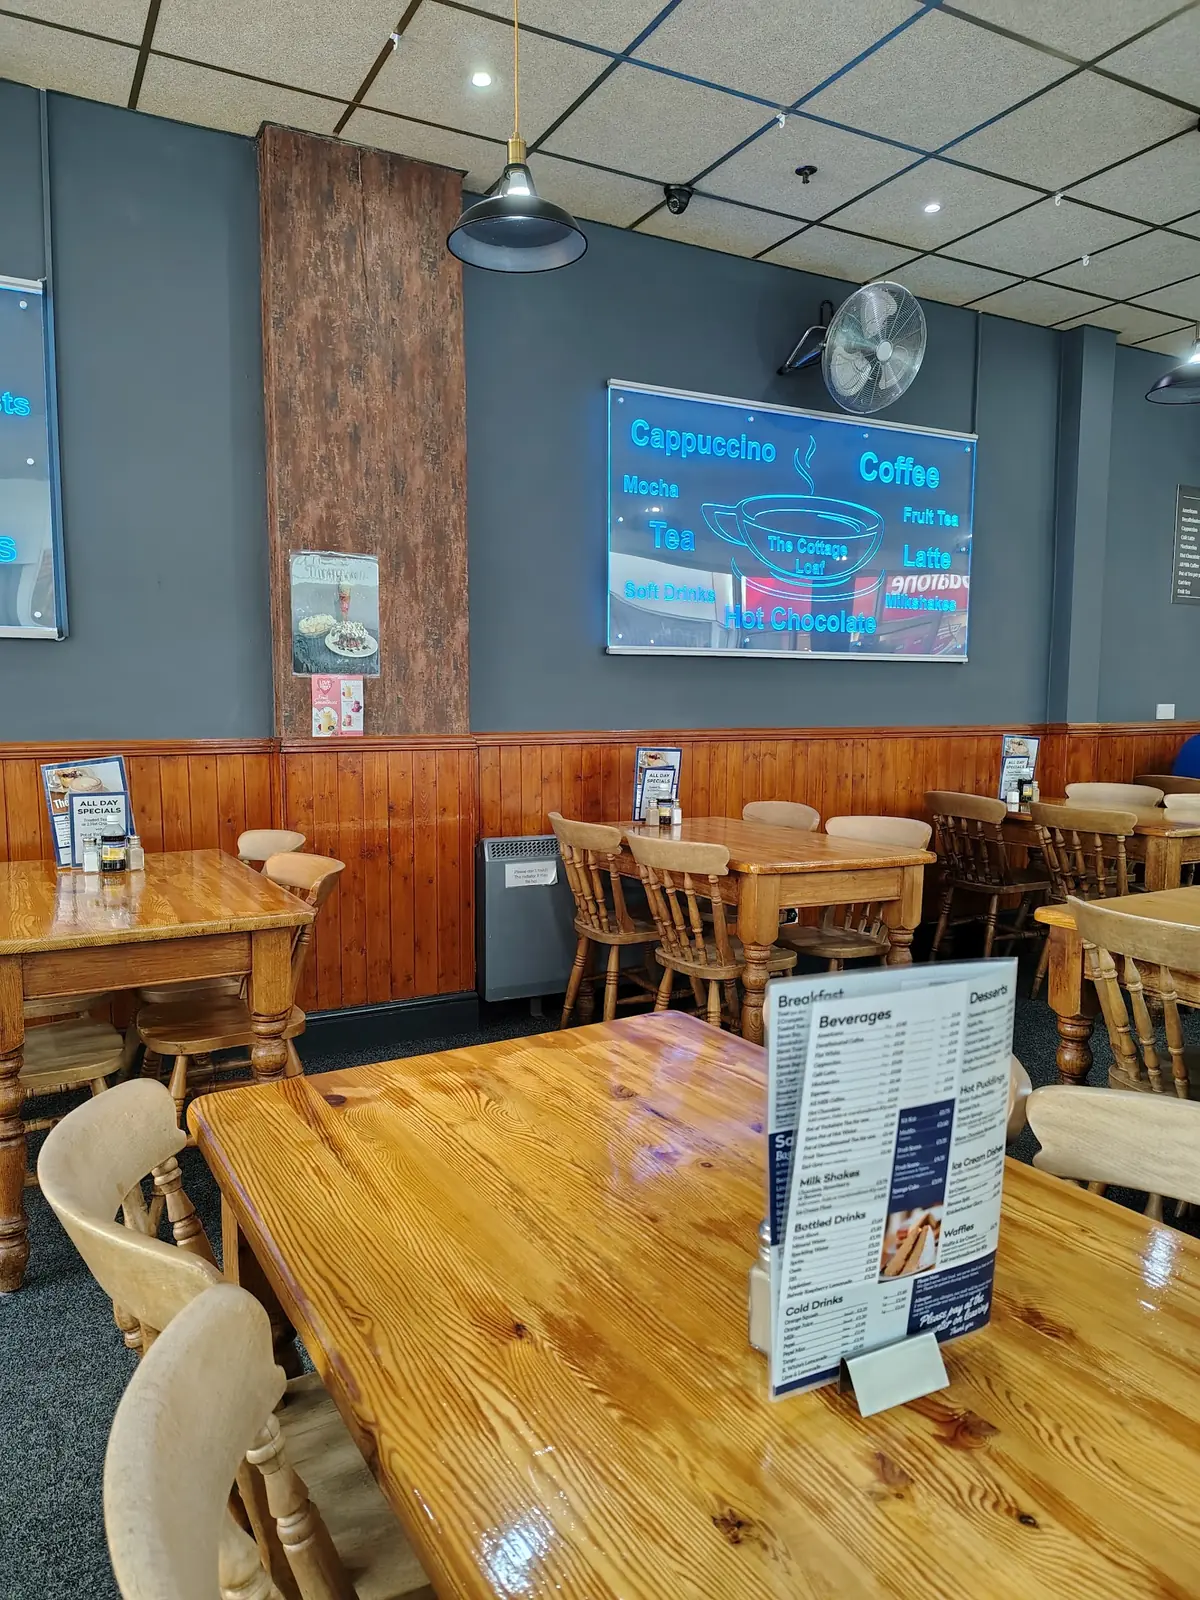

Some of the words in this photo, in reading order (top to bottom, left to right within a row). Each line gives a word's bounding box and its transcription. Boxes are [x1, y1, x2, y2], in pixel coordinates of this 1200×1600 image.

[631, 419, 776, 463] Cappuccino
[859, 452, 940, 488] Coffee
[623, 475, 679, 498] Mocha
[903, 507, 934, 526] Fruit
[937, 510, 959, 527] Tea
[649, 520, 695, 551] Tea
[768, 535, 793, 554] The
[797, 538, 848, 558] Cottage
[795, 558, 825, 576] Loaf
[903, 545, 951, 570] Latte
[625, 581, 659, 600] Soft
[663, 583, 716, 604] Drinks
[886, 593, 956, 612] Milkshakes
[724, 604, 763, 630] Hot
[771, 606, 877, 634] Chocolate
[970, 985, 1008, 1004] Desserts
[819, 1010, 892, 1028] Beverages
[952, 1161, 962, 1171] Ice
[963, 1154, 986, 1167] Cream
[799, 1176, 821, 1187] Milk
[824, 1169, 860, 1182] Shakes
[794, 1216, 832, 1233] Bottled
[833, 1211, 866, 1225] Drinks
[943, 1222, 974, 1239] Waffles
[785, 1302, 809, 1316] Cold
[812, 1296, 843, 1310] Drinks
[920, 1311, 947, 1327] Please
[946, 1304, 963, 1320] pay
[964, 1302, 989, 1320] leaving
